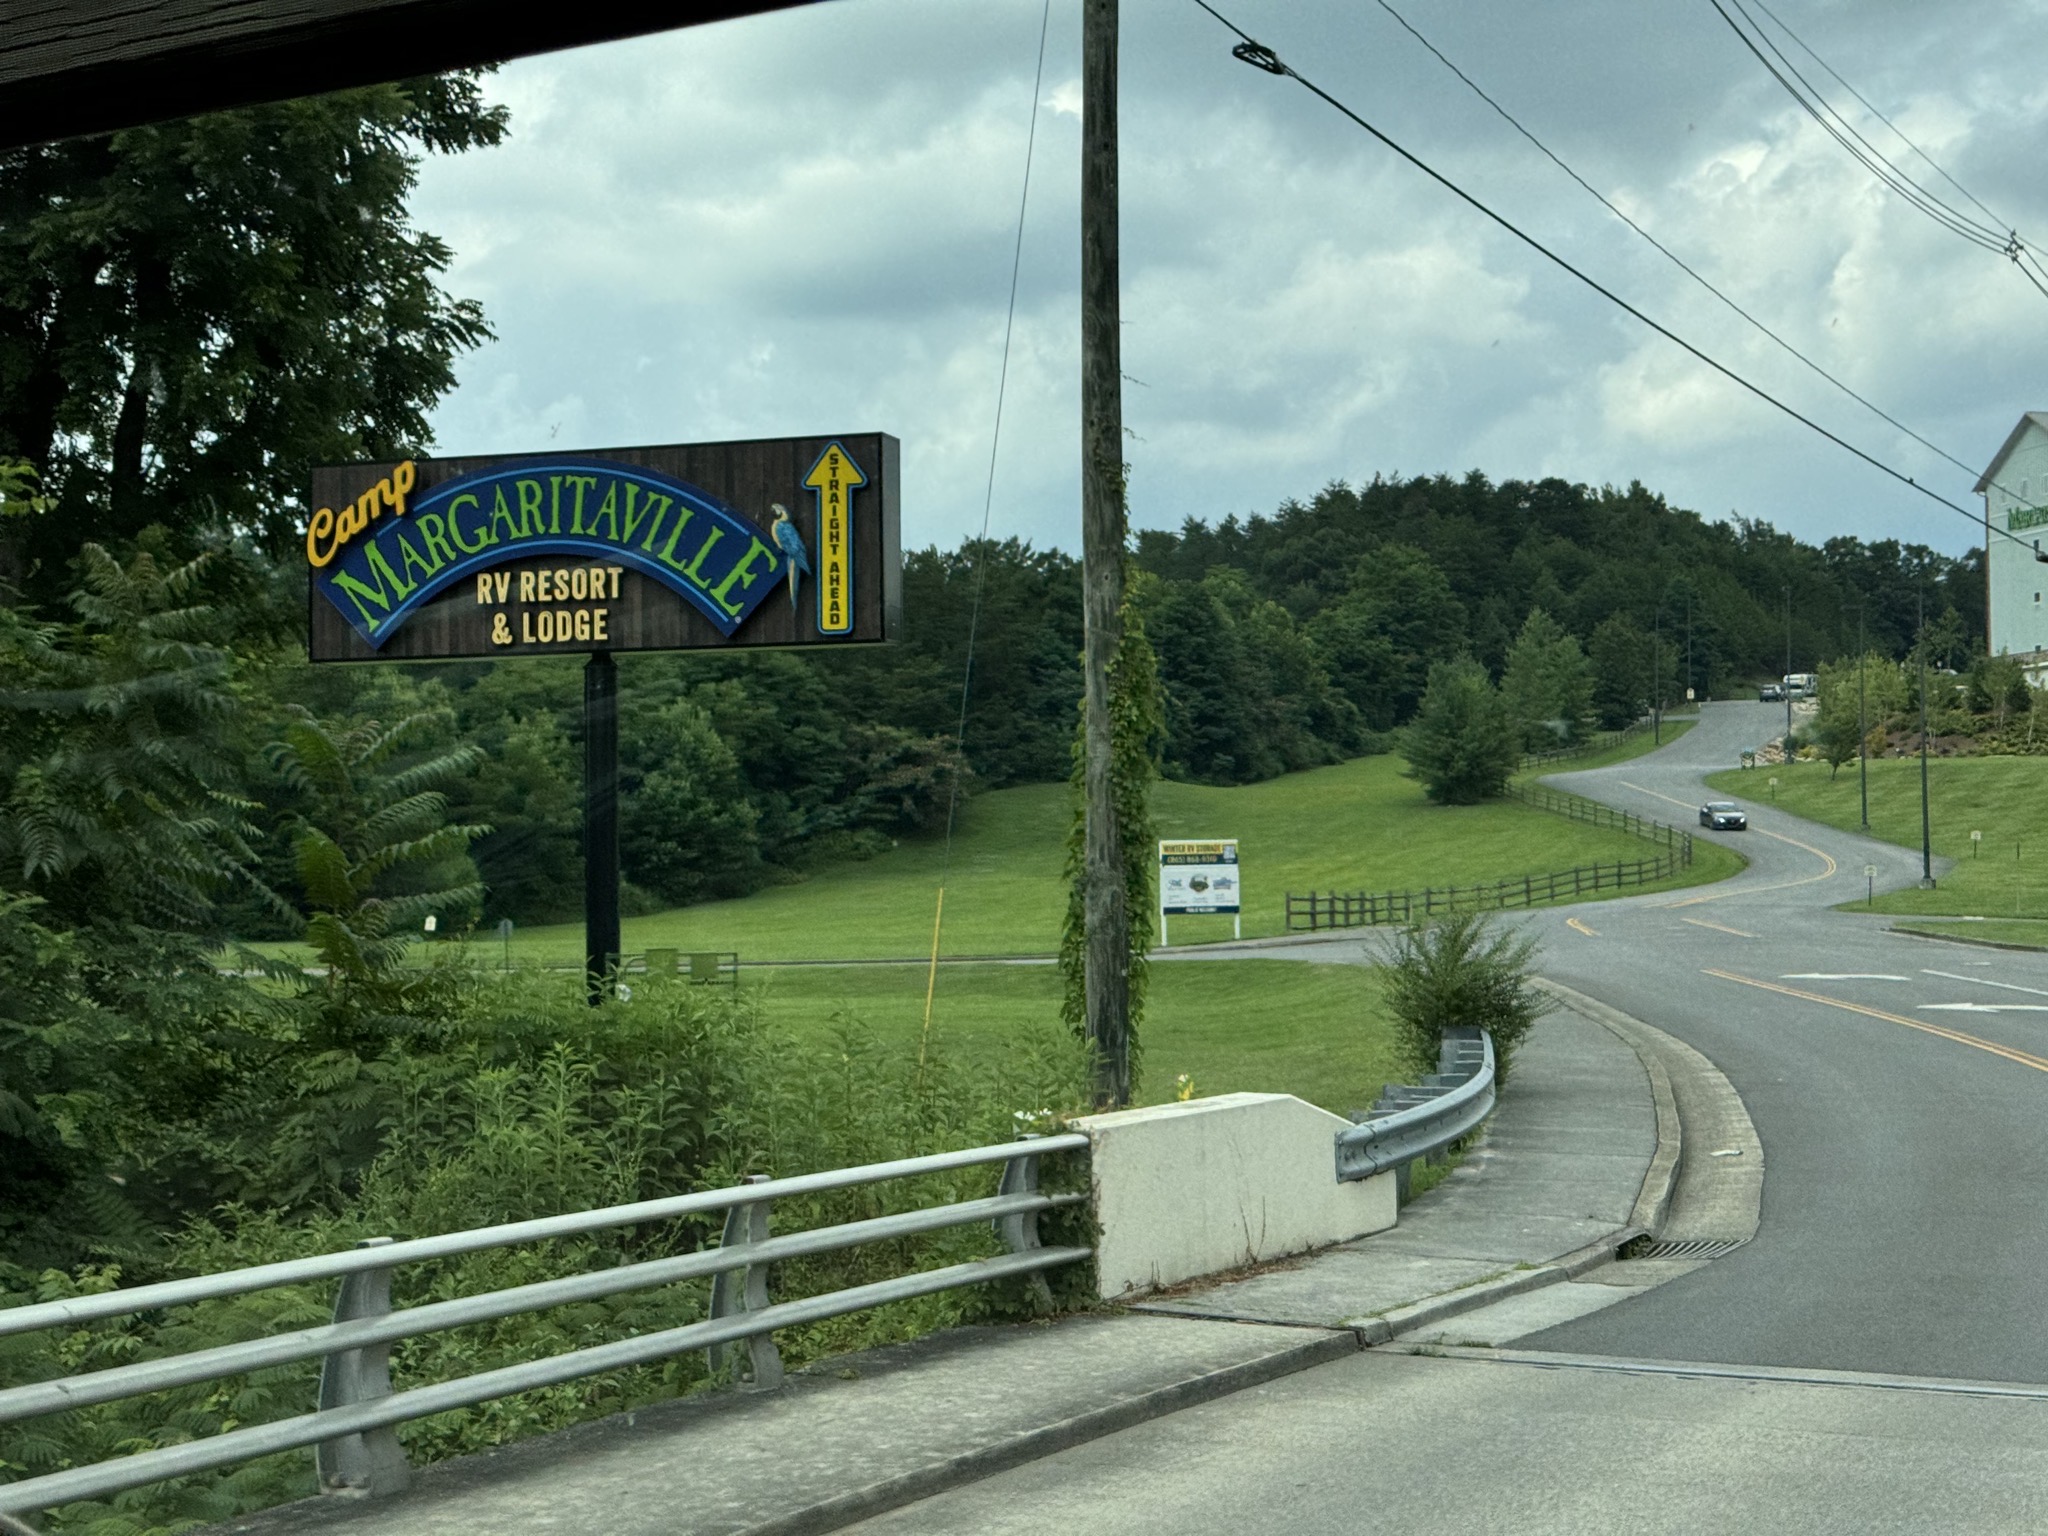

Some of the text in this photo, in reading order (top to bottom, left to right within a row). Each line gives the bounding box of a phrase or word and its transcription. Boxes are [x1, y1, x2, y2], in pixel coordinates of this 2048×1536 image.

[307, 460, 415, 568] Camp
[330, 474, 778, 633] MARGARITAVILLE
[828, 452, 841, 626] STRAIGHT AHEAD
[477, 566, 624, 605] RV RESORT
[491, 608, 609, 645] & LODGE
